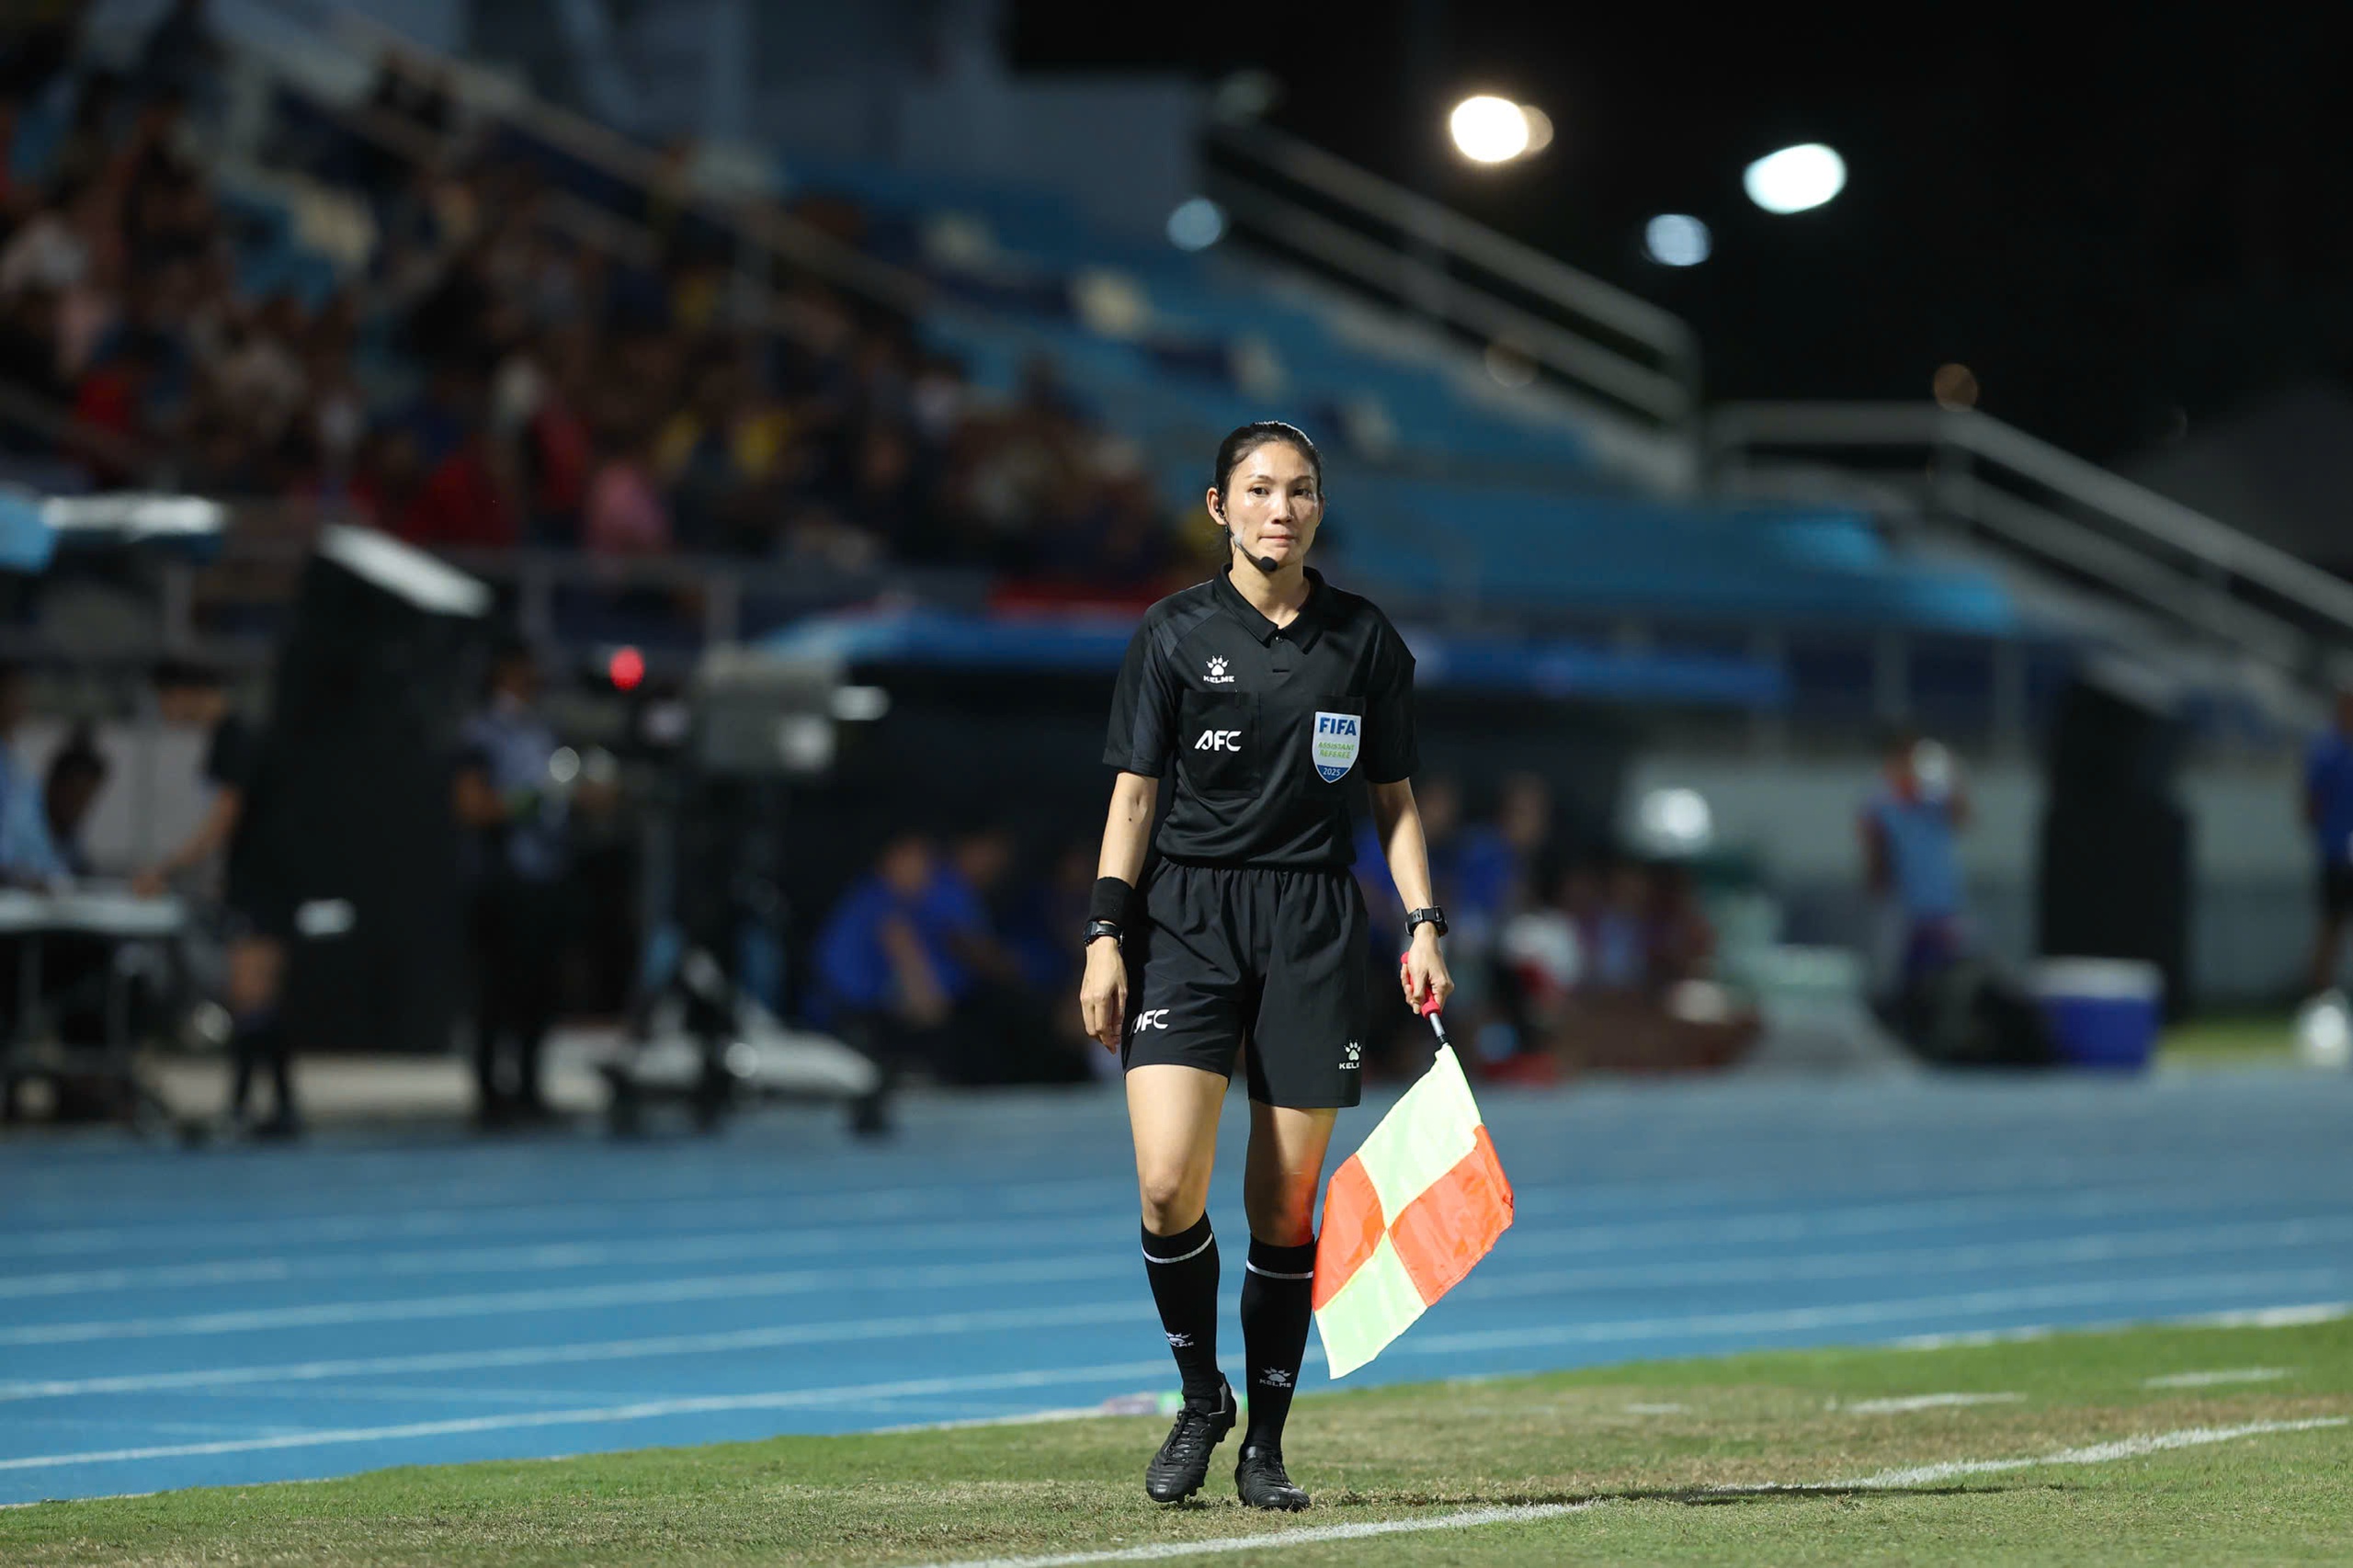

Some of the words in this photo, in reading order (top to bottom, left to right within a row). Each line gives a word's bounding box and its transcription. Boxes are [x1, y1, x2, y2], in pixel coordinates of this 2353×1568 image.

[1203, 675, 1234, 683] KELME
[1319, 717, 1357, 735] FIFA
[1194, 730, 1242, 752] AFC
[1317, 742, 1356, 751] ASSISTANT
[1320, 749, 1352, 759] REFEREE
[1324, 767, 1341, 777] 2025
